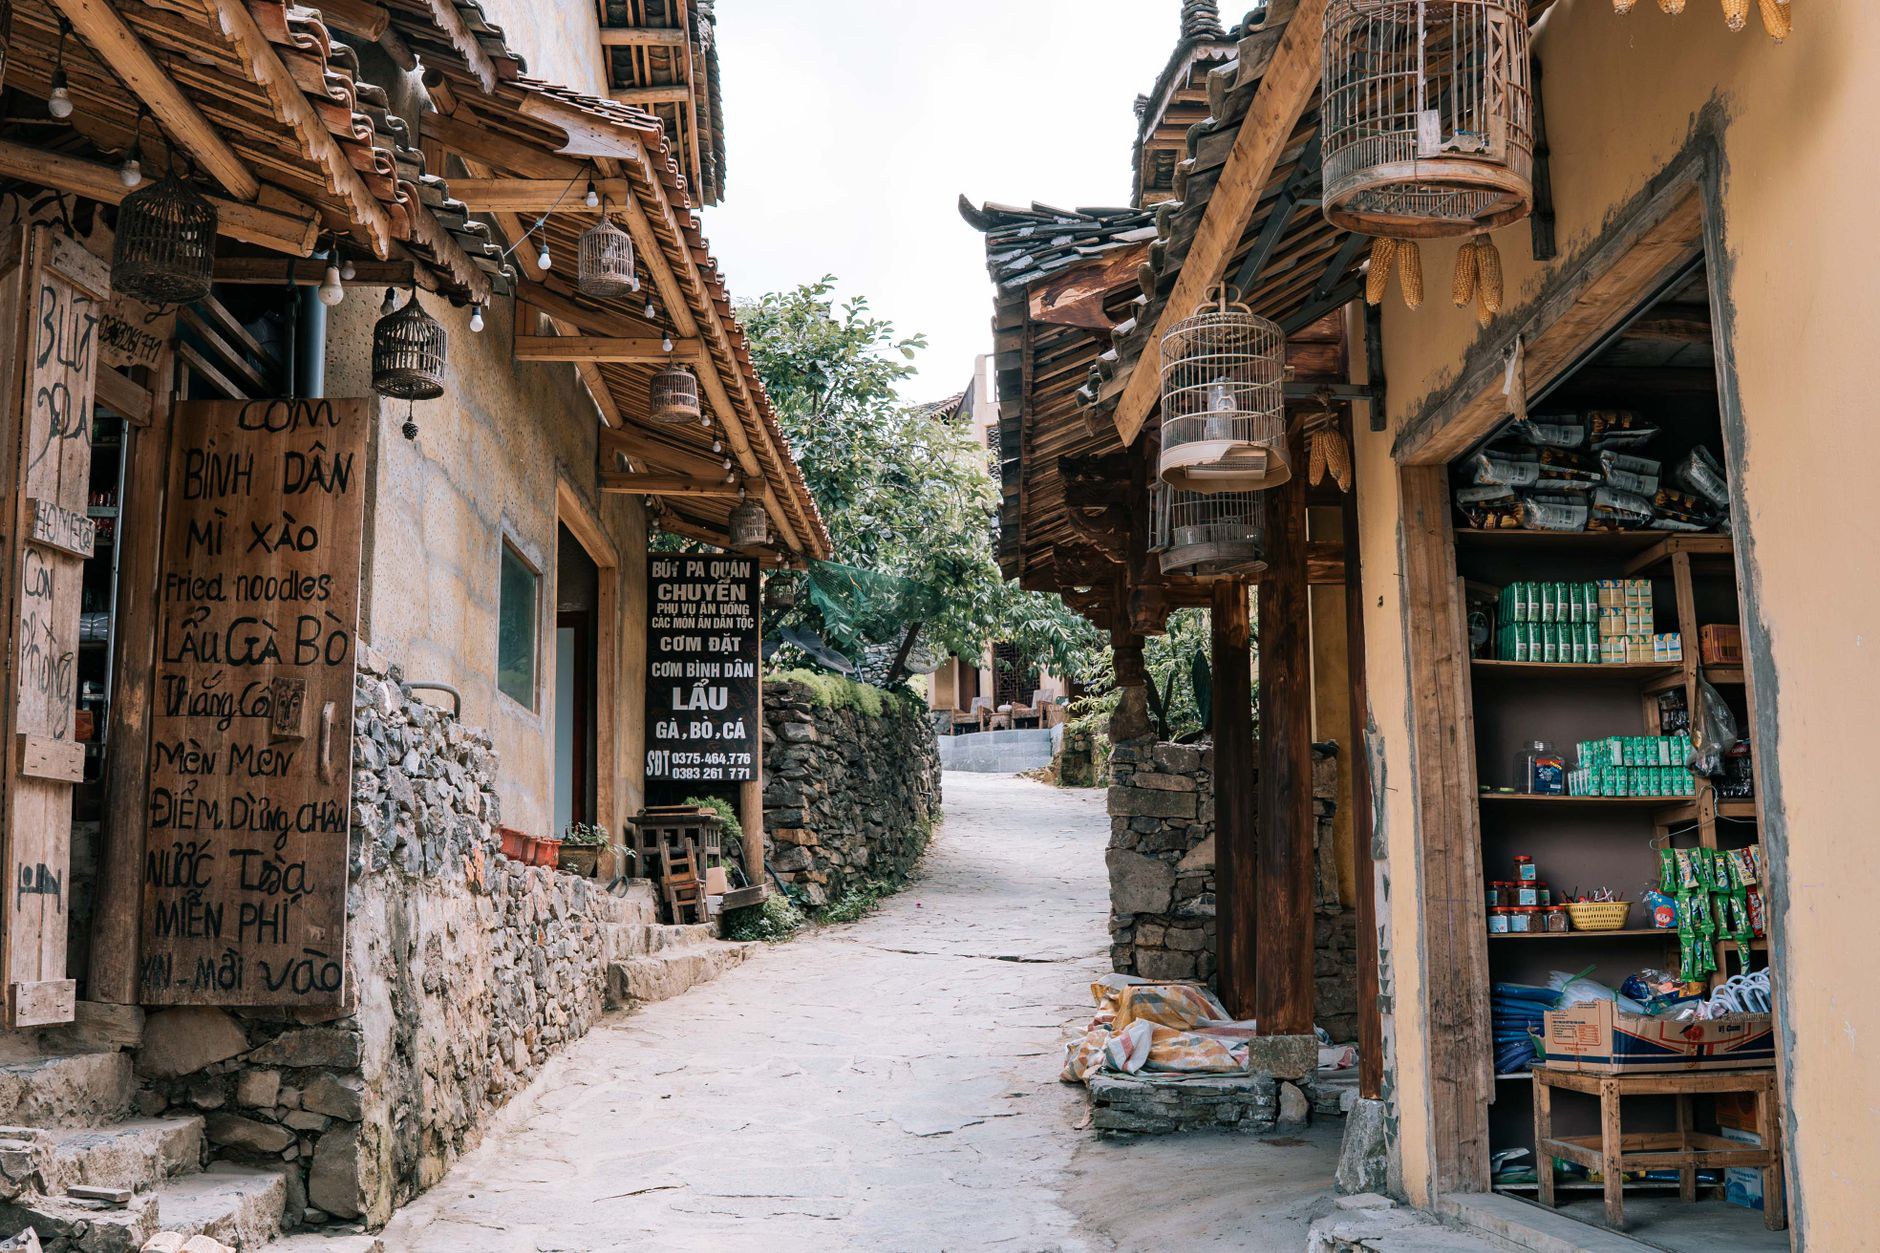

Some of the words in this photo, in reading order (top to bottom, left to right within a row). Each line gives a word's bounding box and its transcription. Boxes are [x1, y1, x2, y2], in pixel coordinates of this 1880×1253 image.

[184, 439, 254, 500] BÌNH
[284, 440, 355, 496] DÂN
[186, 508, 228, 558] MÌ
[247, 511, 319, 554] XÀO
[686, 562, 706, 578] PA
[710, 559, 751, 580] QUÁN
[165, 571, 227, 602] Fried
[235, 569, 333, 602] noodles
[651, 615, 671, 630] CÁC
[673, 615, 696, 629] MÓN
[698, 615, 713, 630] ĂN
[713, 615, 735, 630] DÂN
[736, 614, 755, 631] TỘC
[656, 603, 679, 617] PHỤ
[681, 603, 697, 617] VỤ
[699, 601, 717, 616] ĂN
[720, 601, 751, 616] UỐNG
[295, 610, 349, 667] BÒ
[660, 635, 702, 652] CƠM
[708, 633, 742, 655] ĐẶT
[651, 662, 683, 678] CƠM
[686, 659, 720, 678] BÌNH
[724, 658, 755, 678] DÂN
[672, 678, 729, 711] LẨU
